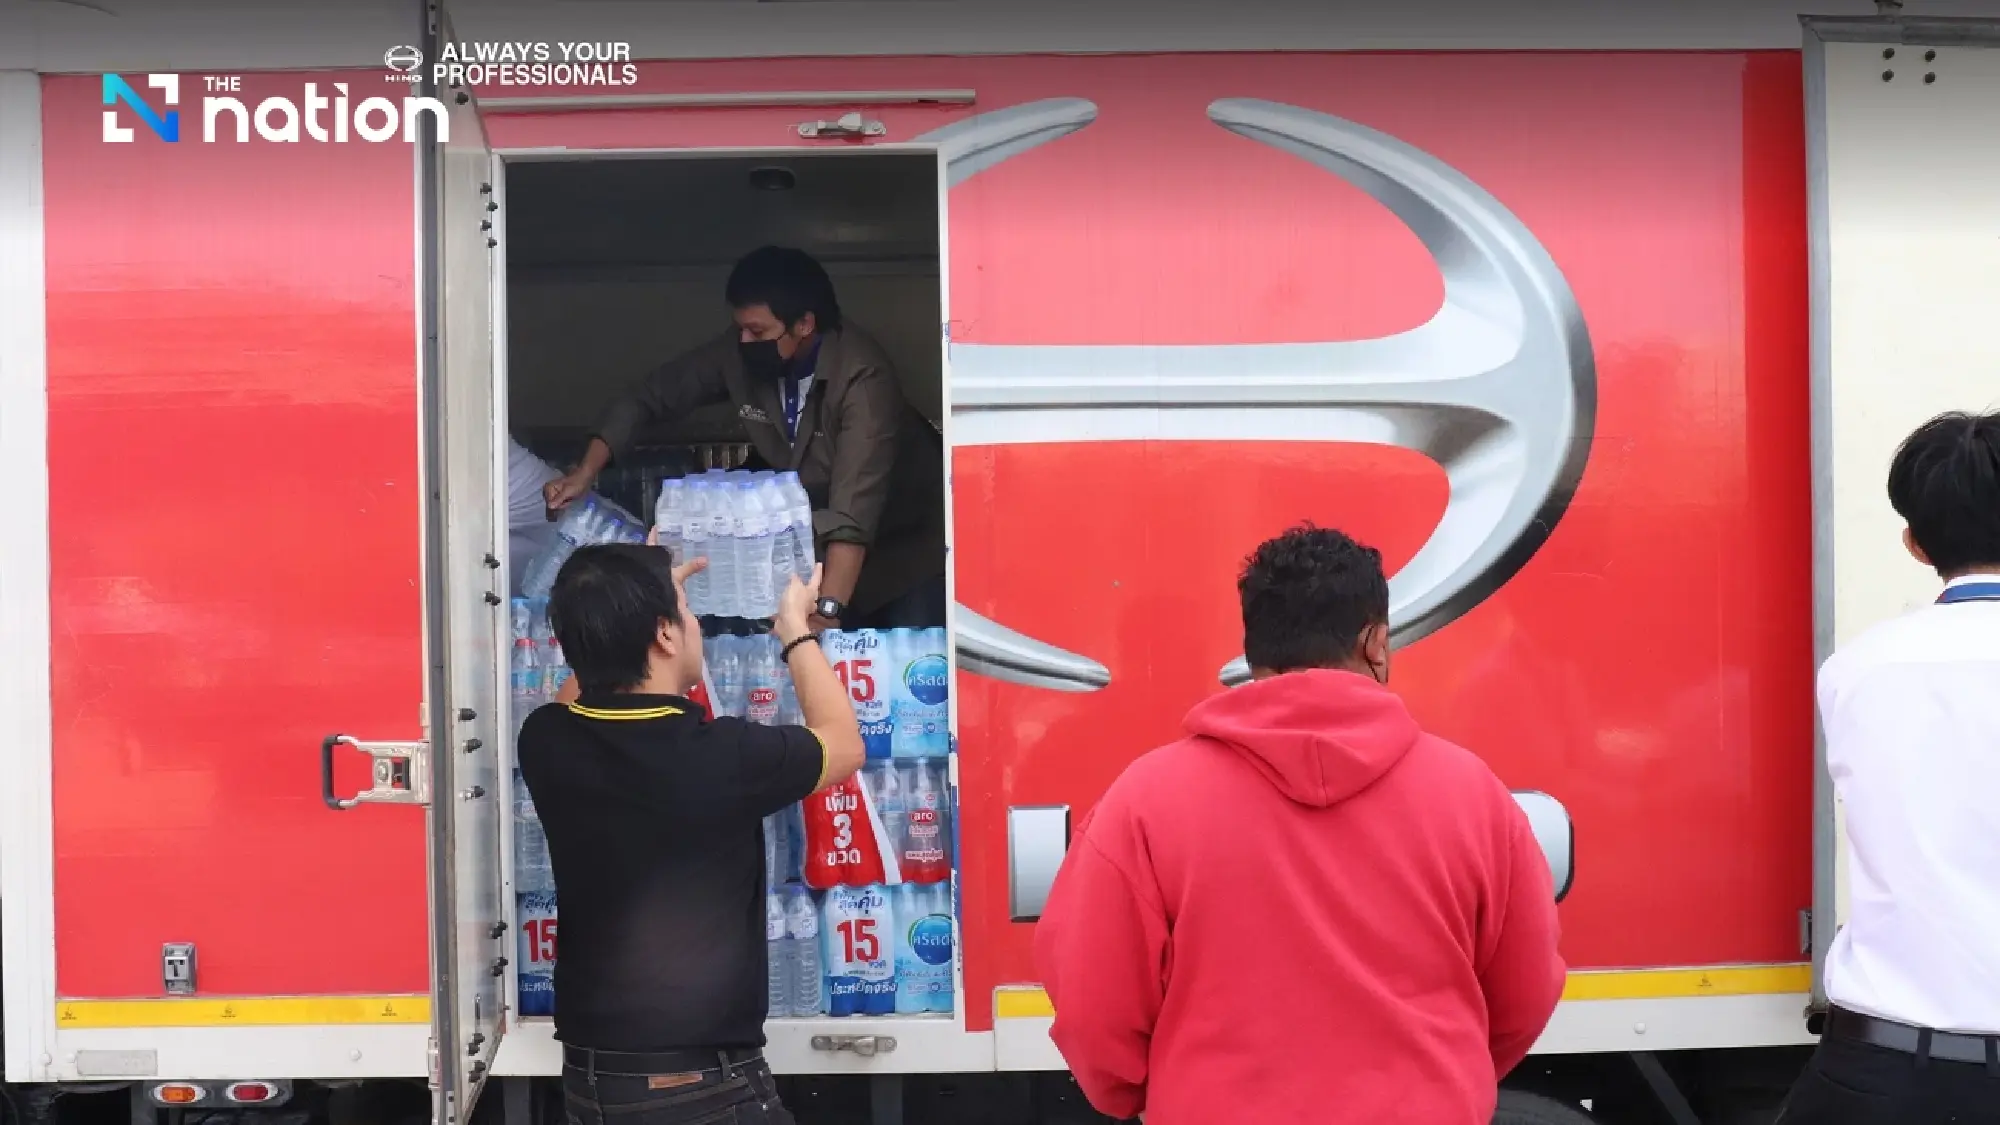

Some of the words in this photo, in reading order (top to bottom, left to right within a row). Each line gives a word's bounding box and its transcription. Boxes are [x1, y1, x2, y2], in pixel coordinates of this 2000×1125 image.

[833, 659, 875, 702] 15
[825, 785, 858, 811] เพิ่ม
[833, 813, 852, 849] 3
[827, 849, 861, 866] ขวด
[523, 919, 558, 962] 15
[837, 919, 879, 963] 15
